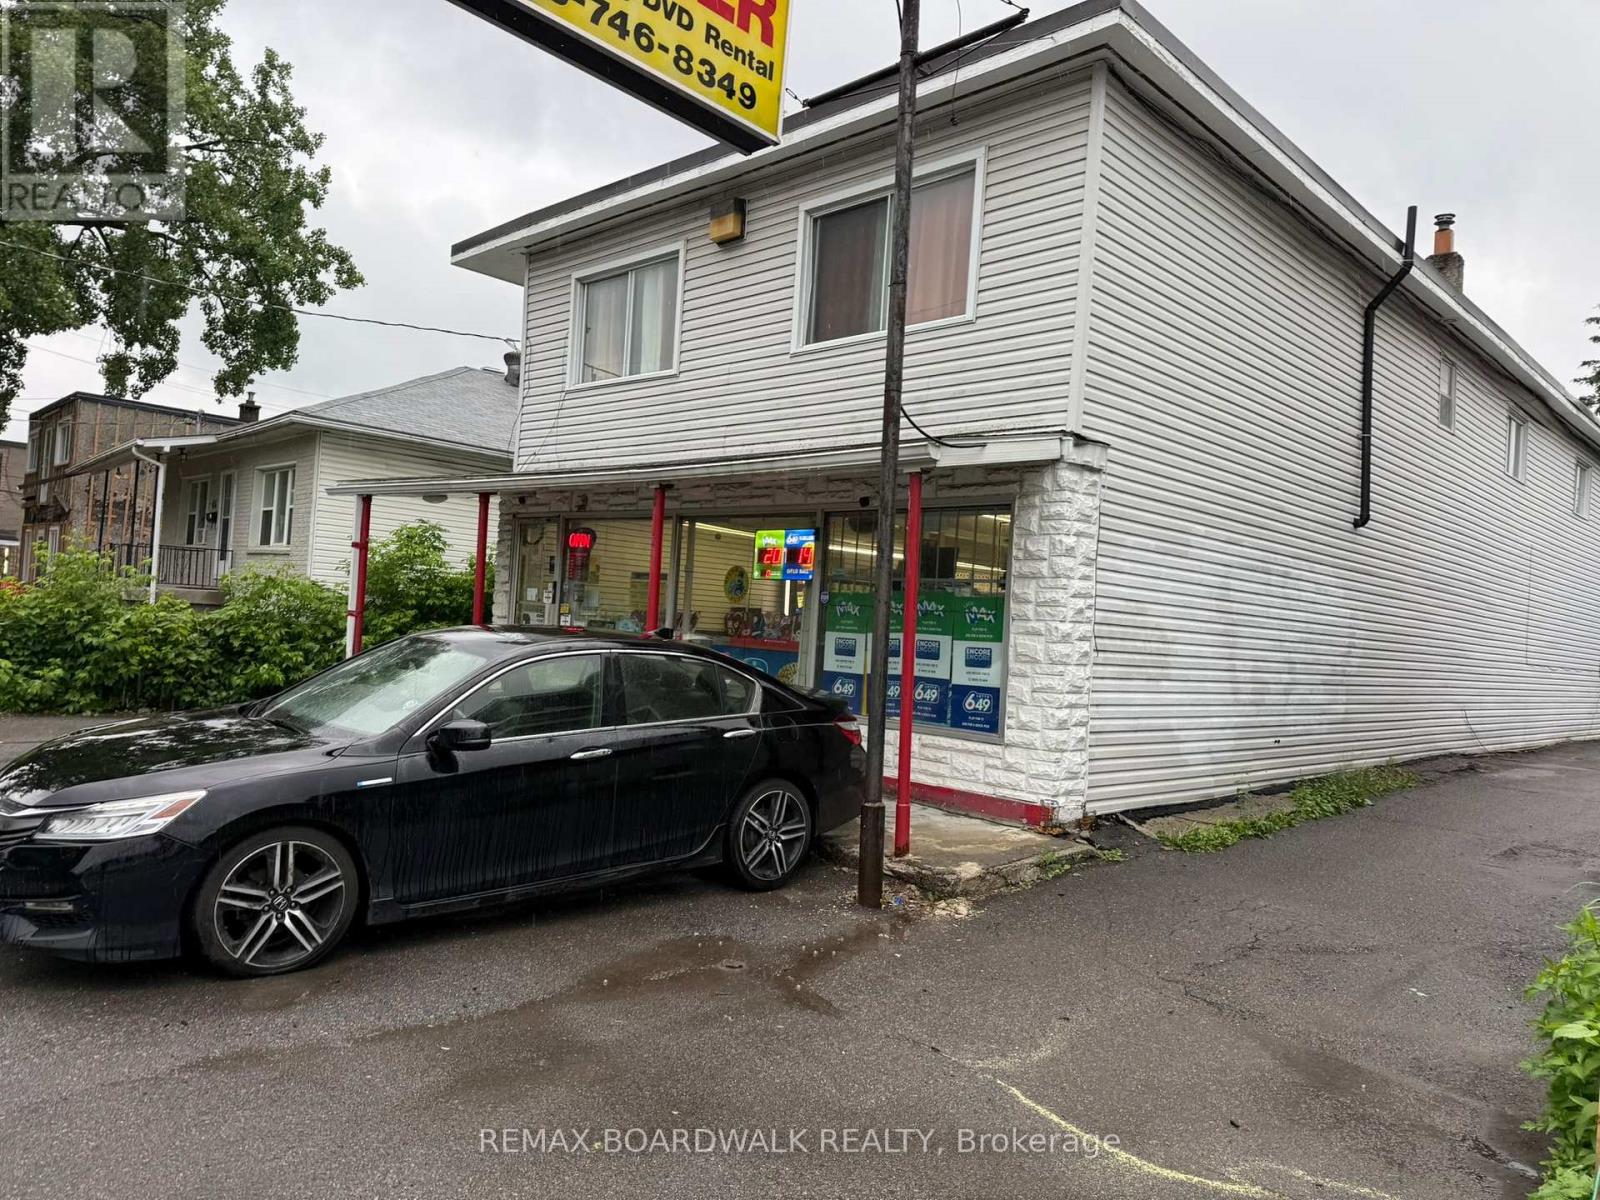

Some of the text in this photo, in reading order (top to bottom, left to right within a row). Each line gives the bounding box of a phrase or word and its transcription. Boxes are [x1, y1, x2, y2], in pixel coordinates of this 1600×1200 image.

[551, 0, 757, 110] -746-8349
[704, 22, 775, 82] Rental
[569, 533, 591, 548] OPEN
[966, 648, 991, 656] ENCORE
[887, 685, 901, 698] 49
[914, 682, 938, 701] 649
[965, 693, 991, 712] 649
